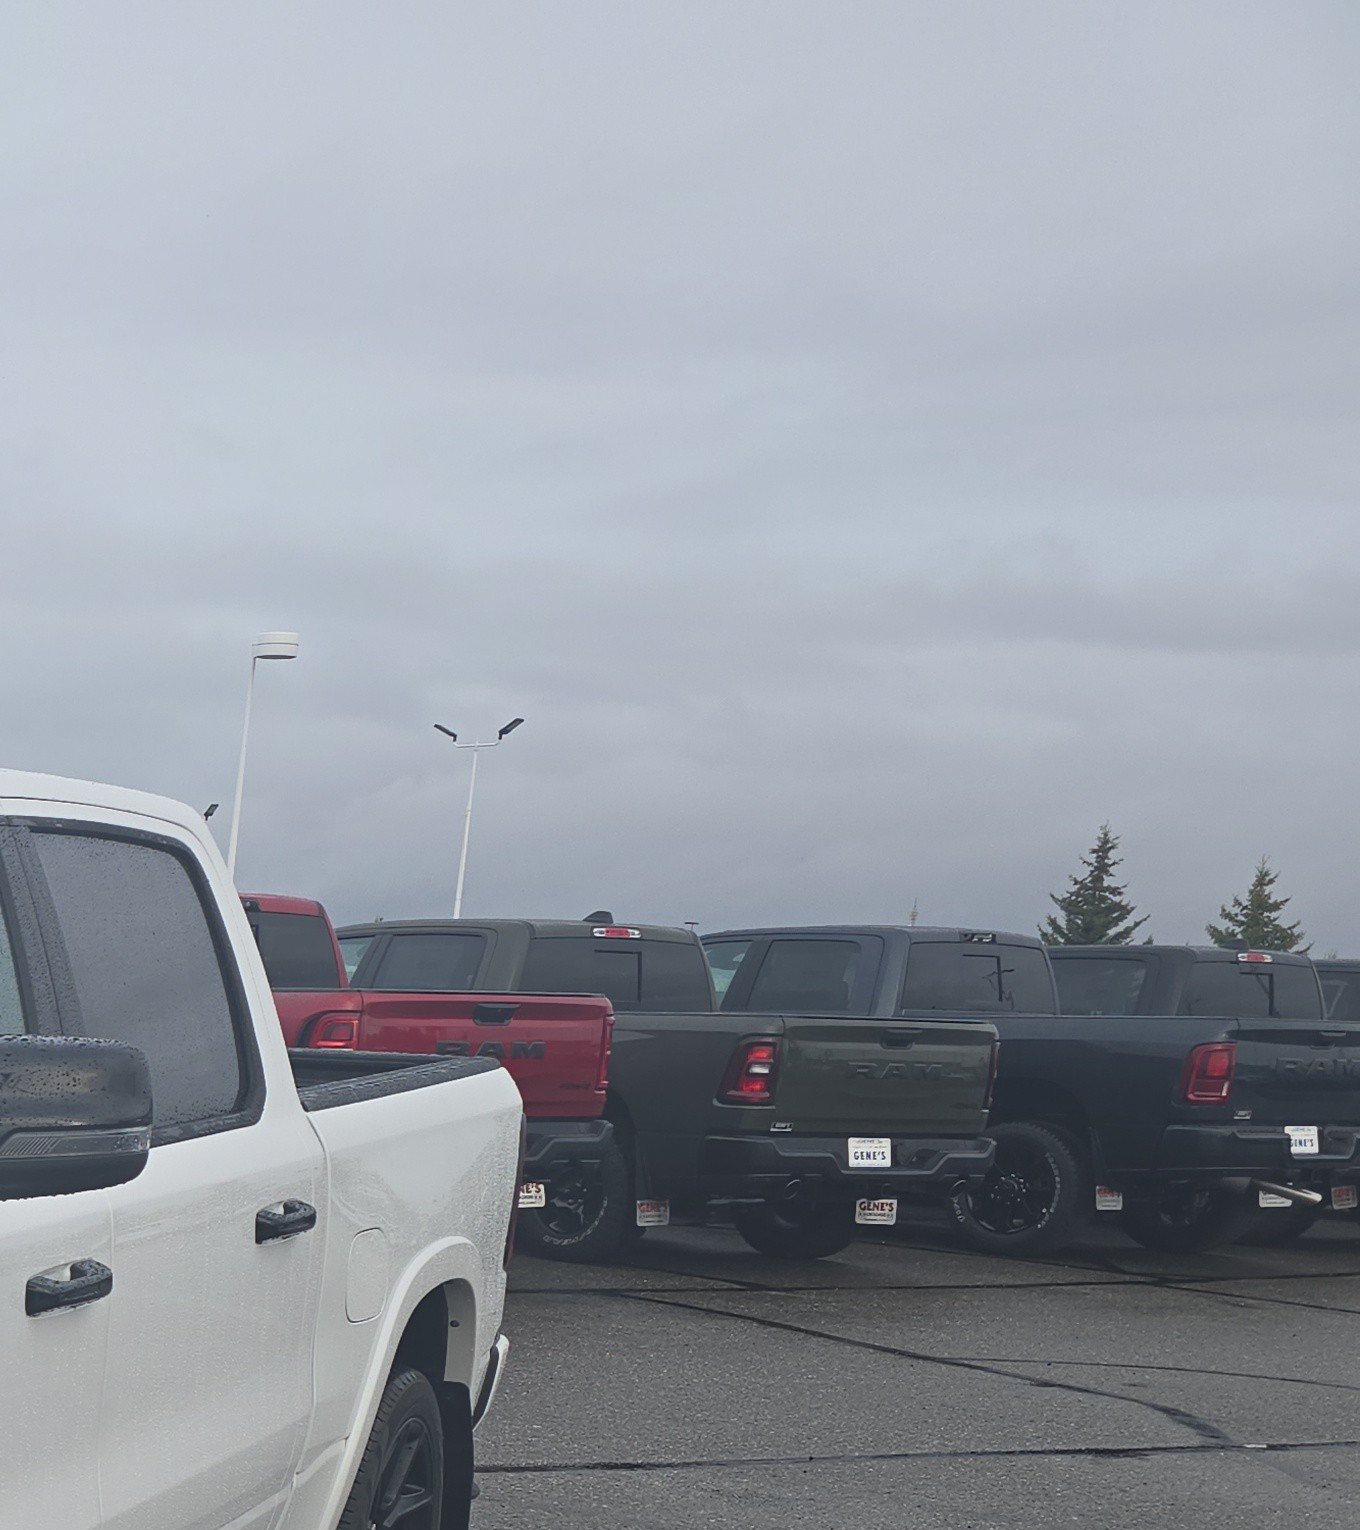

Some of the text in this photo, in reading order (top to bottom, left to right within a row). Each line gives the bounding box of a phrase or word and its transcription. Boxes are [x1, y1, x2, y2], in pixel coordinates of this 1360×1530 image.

[435, 1040, 546, 1059] RAM
[847, 1062, 943, 1080] RAM
[853, 1151, 887, 1161] GENE'S
[859, 1201, 894, 1212] GENE'S
